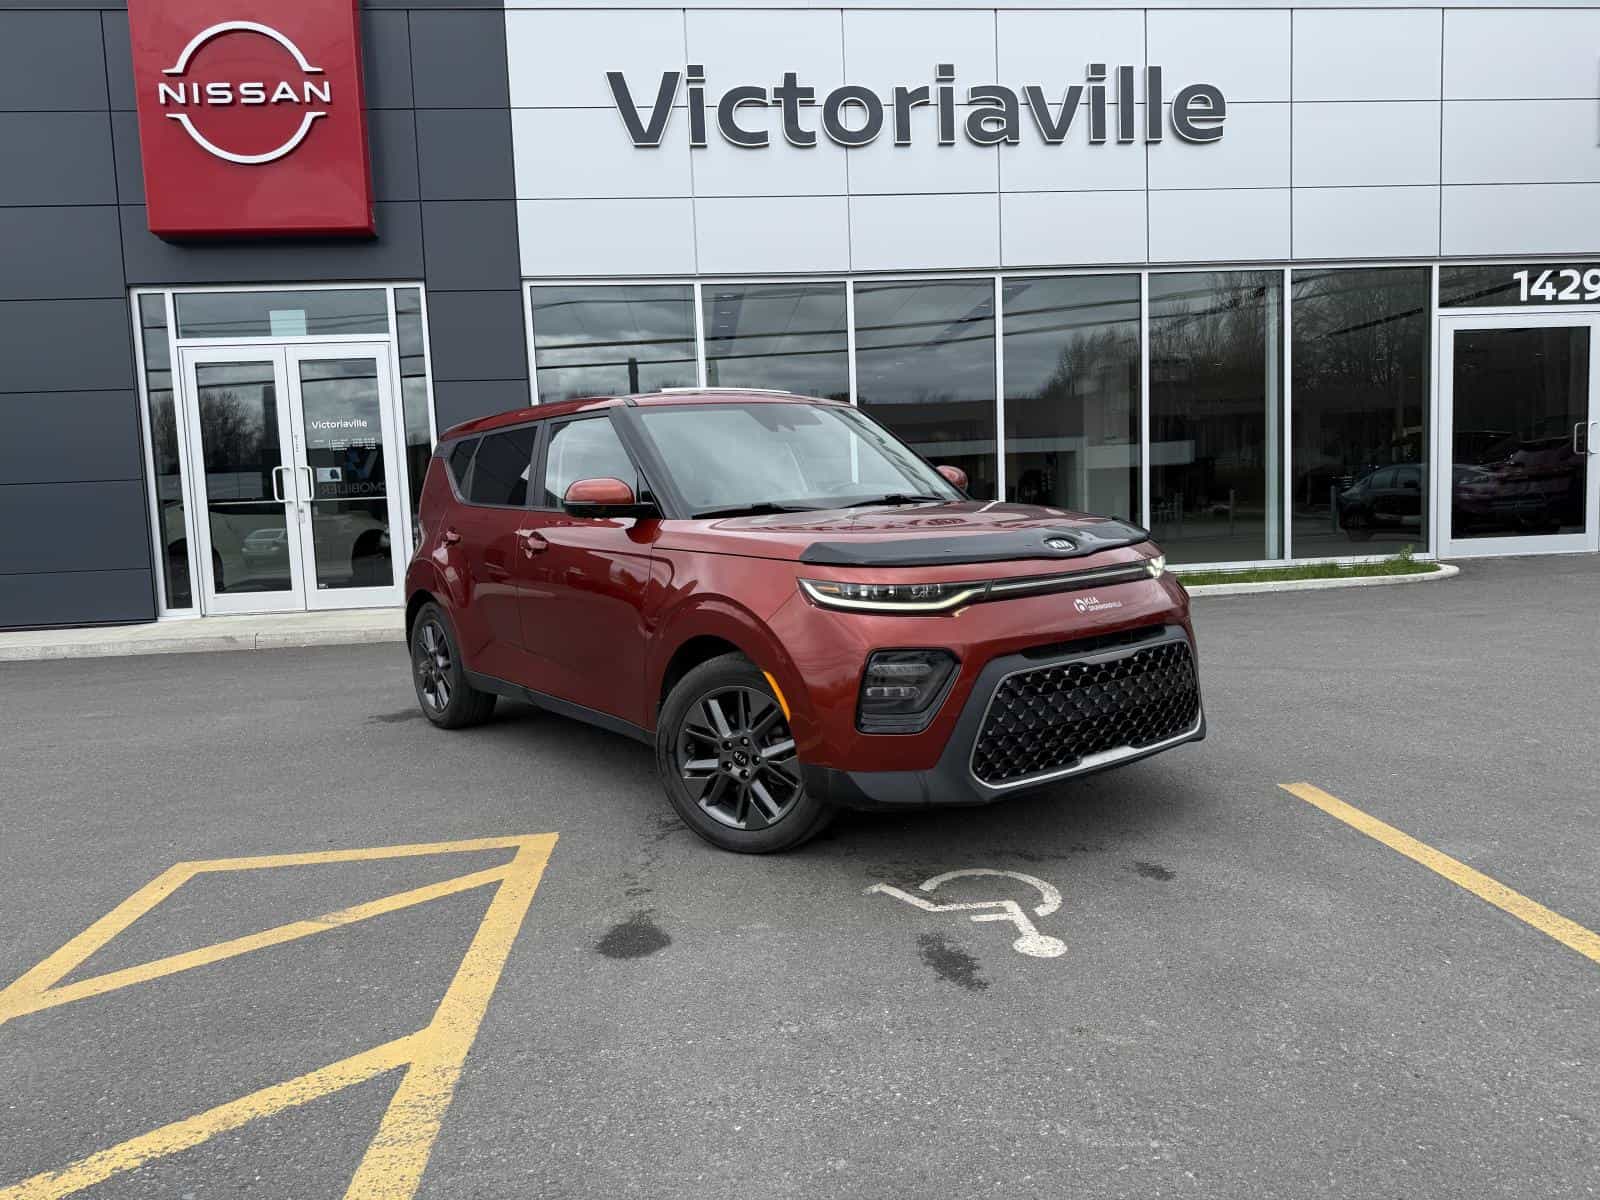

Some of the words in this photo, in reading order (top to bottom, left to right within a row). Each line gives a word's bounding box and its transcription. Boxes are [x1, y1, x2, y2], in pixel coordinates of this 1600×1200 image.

[157, 81, 331, 104] NISSAN
[606, 63, 1227, 148] Victoriaville
[1513, 269, 1600, 302] 1429
[312, 418, 368, 429] Victoriaville
[1048, 538, 1072, 549] KIA
[734, 751, 746, 764] KIA
